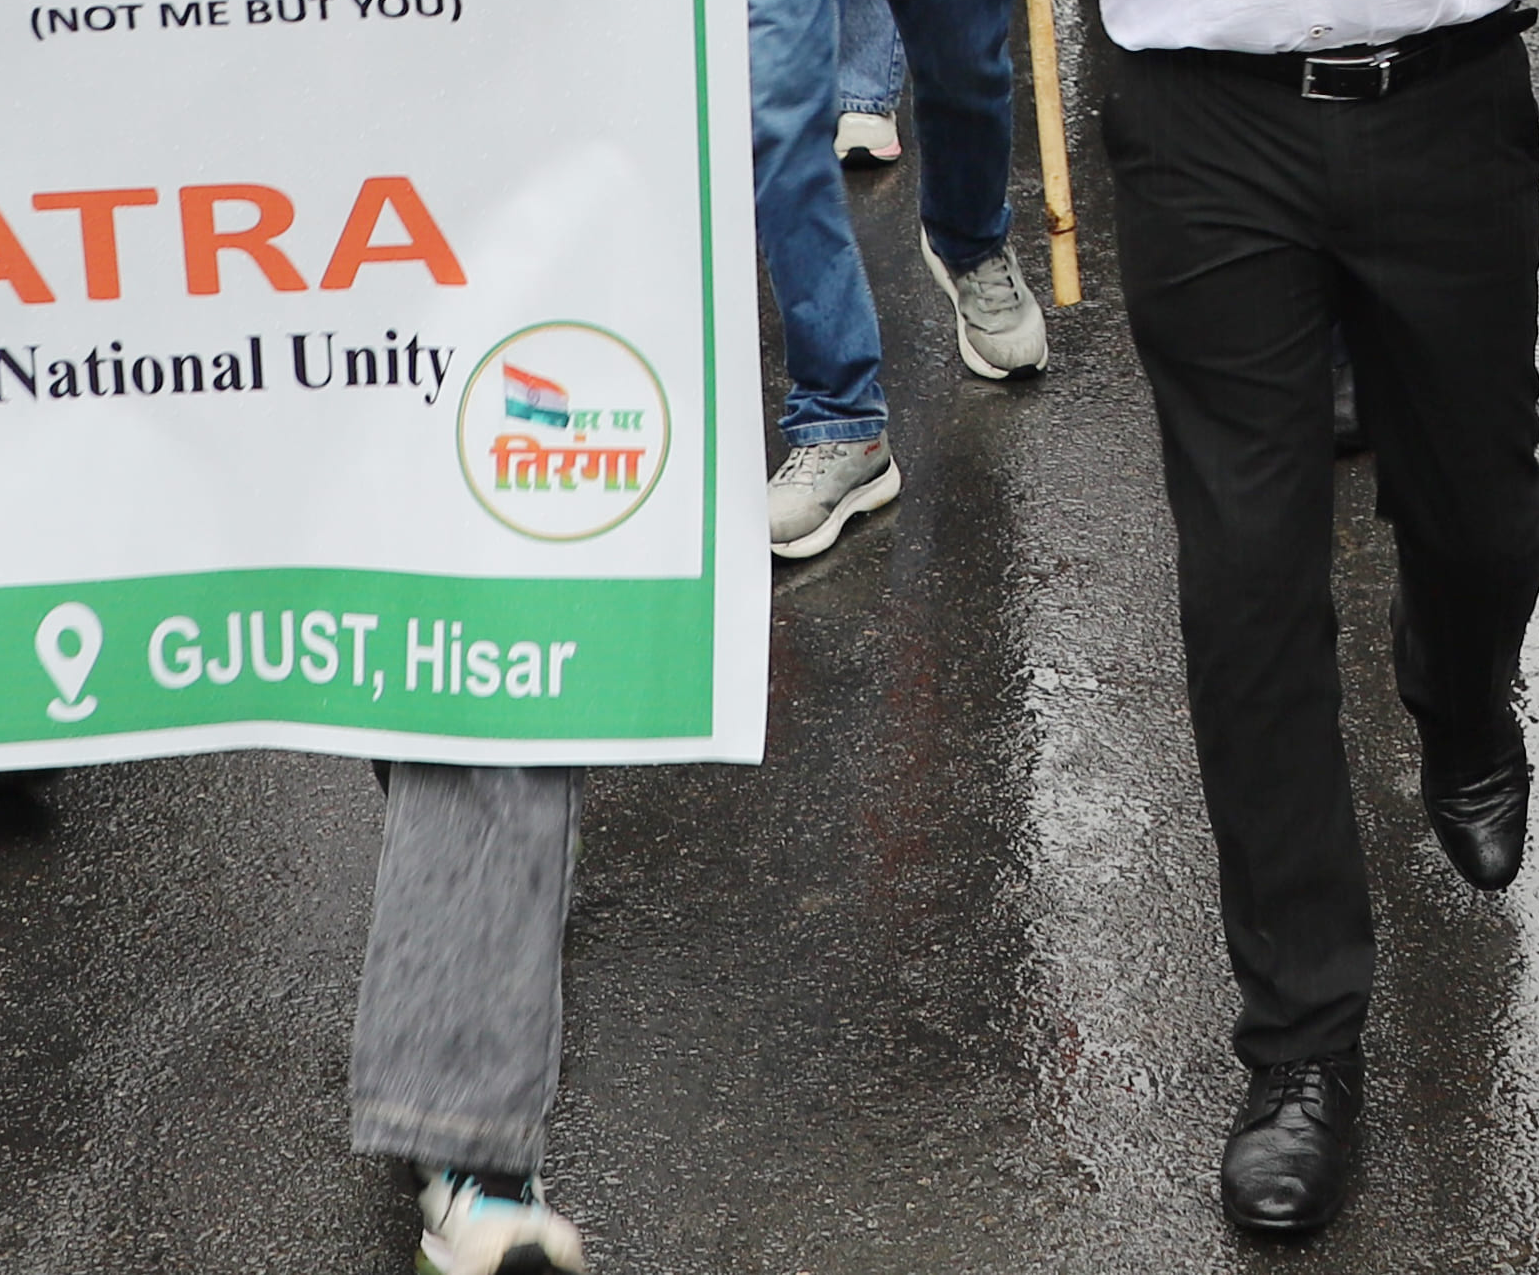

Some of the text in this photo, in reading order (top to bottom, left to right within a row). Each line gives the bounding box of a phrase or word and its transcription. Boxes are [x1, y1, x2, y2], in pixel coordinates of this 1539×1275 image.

[29, 2, 141, 44] (NOT
[158, 0, 231, 28] ME
[289, 329, 456, 404] Unity
[488, 432, 647, 492] तिरंगा
[147, 609, 577, 703] GJUST, Hisar
